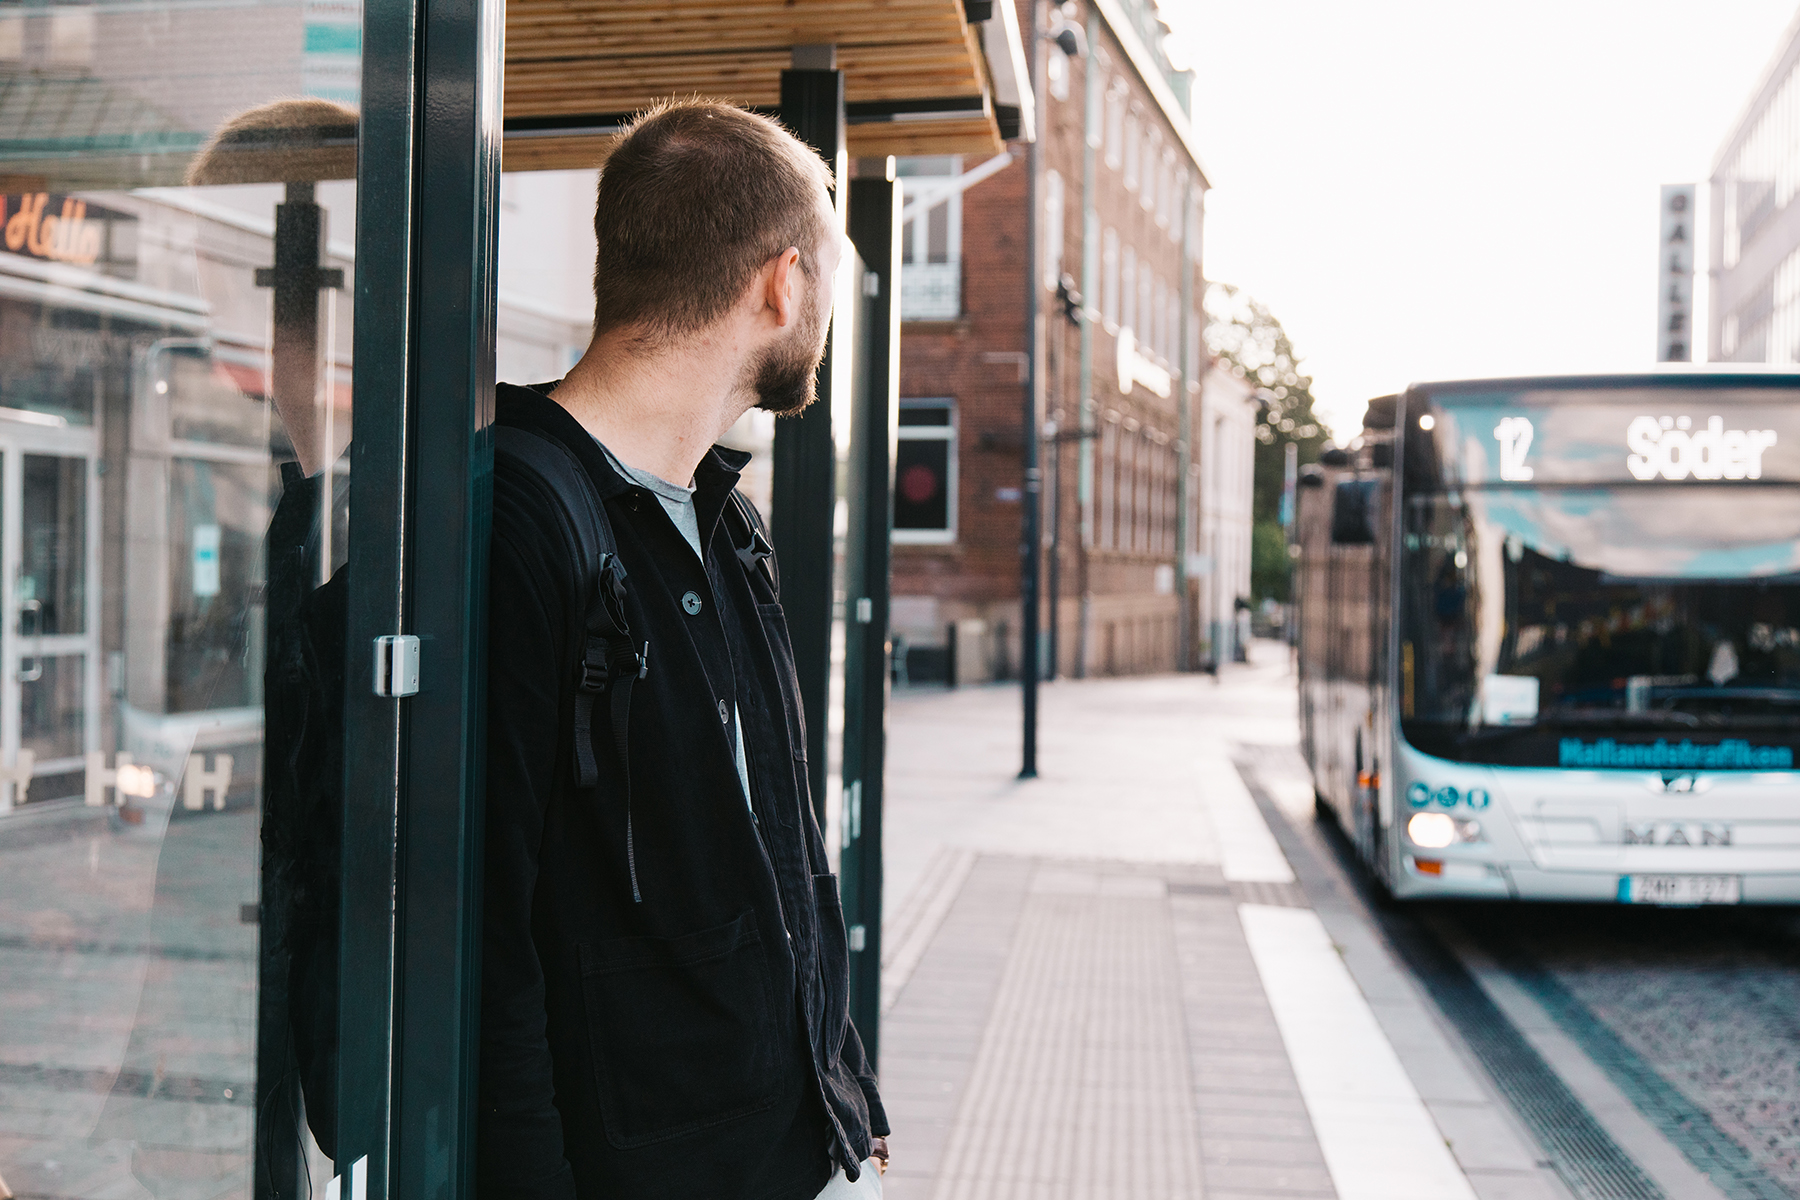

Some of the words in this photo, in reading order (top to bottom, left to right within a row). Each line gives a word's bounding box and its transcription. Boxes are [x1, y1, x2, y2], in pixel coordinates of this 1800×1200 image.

[1494, 417, 1534, 481] 12
[1627, 415, 1777, 480] Söder
[1559, 737, 1794, 768] Hallandstrafiken
[1623, 822, 1732, 846] MAN
